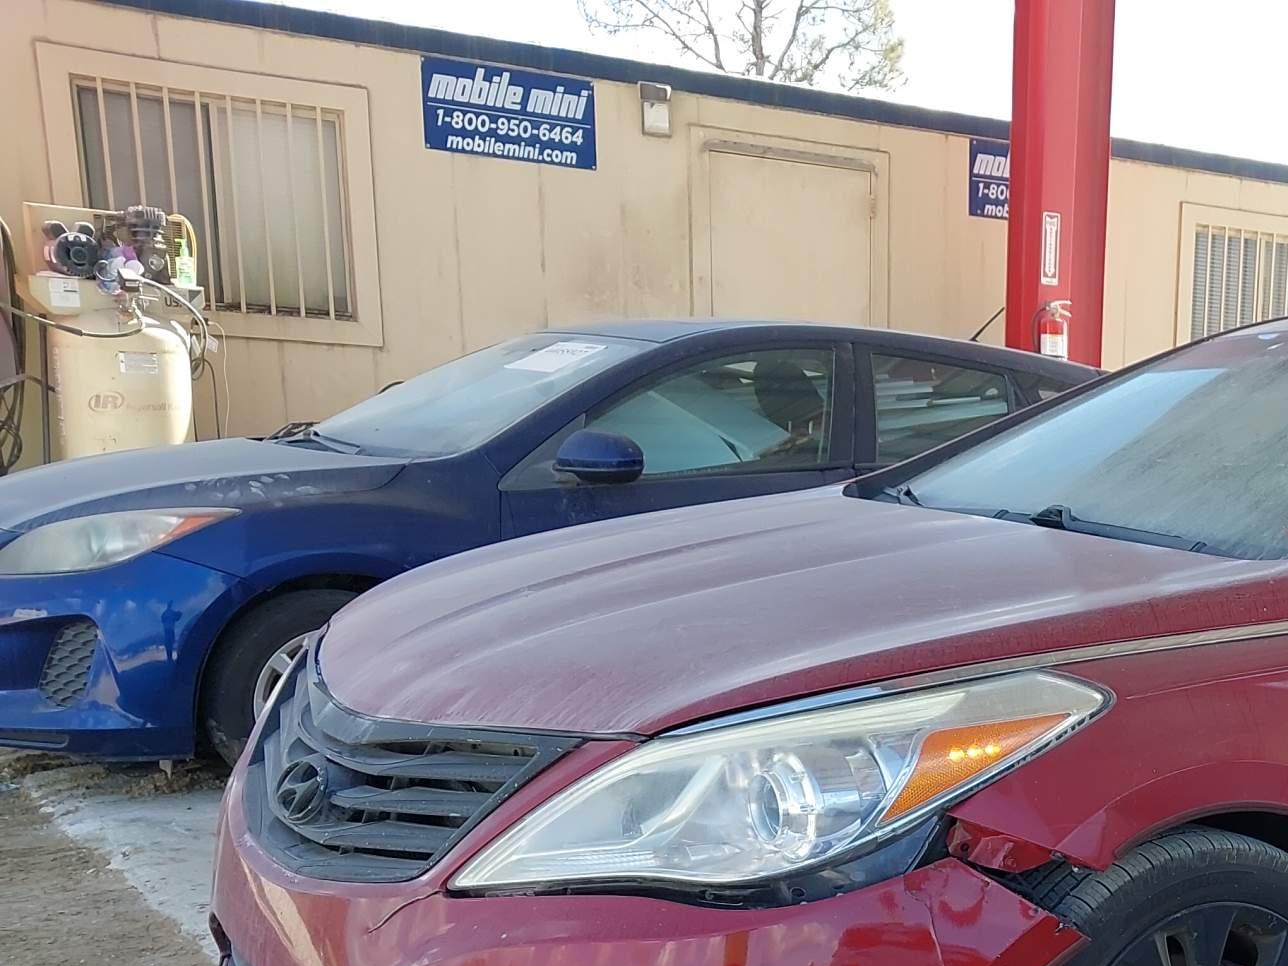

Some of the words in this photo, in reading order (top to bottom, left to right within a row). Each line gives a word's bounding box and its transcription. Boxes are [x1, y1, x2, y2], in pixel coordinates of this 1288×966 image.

[428, 67, 524, 111] mobile
[526, 86, 588, 120] mini
[435, 108, 584, 146] 1-800-950-6464
[446, 134, 578, 165] mobilemini.com
[978, 182, 1009, 200] 1-80
